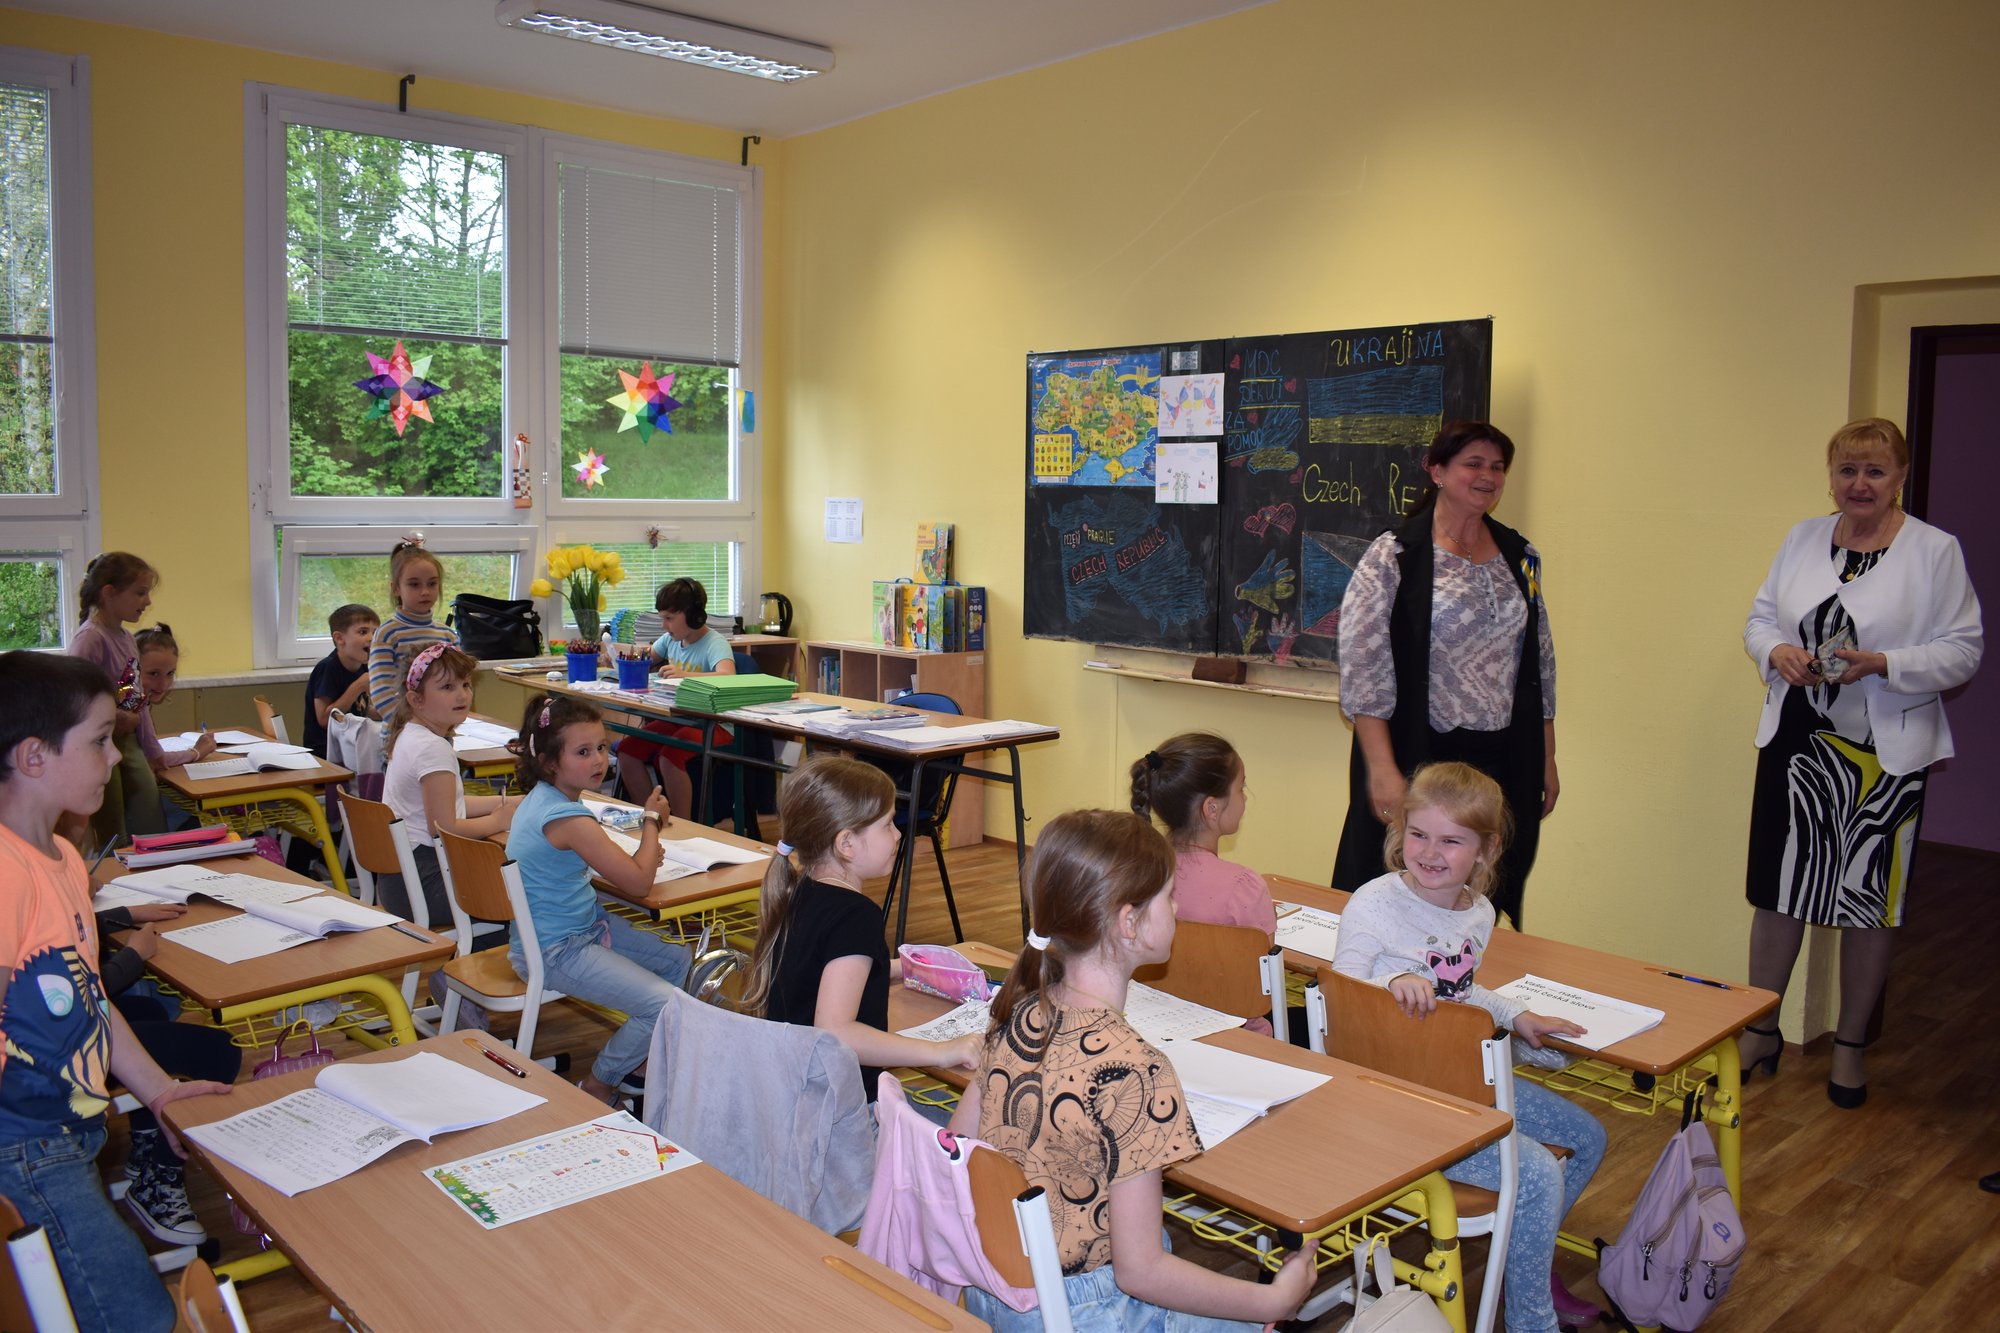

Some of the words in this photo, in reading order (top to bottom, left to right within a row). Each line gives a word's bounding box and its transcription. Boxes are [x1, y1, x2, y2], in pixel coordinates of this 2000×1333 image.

[1243, 349, 1281, 378] MOC
[1225, 411, 1245, 430] ZA
[1302, 461, 1361, 506] Czech
[1388, 462, 1424, 516] RE
[1071, 554, 1108, 582] CZECH
[1115, 527, 1165, 570] REPUBLIC
[1515, 984, 1542, 994] první
[1541, 990, 1569, 1003] česká
[1569, 1000, 1596, 1010] slova
[1525, 980, 1547, 989] Vaše
[1558, 990, 1582, 1000] naše
